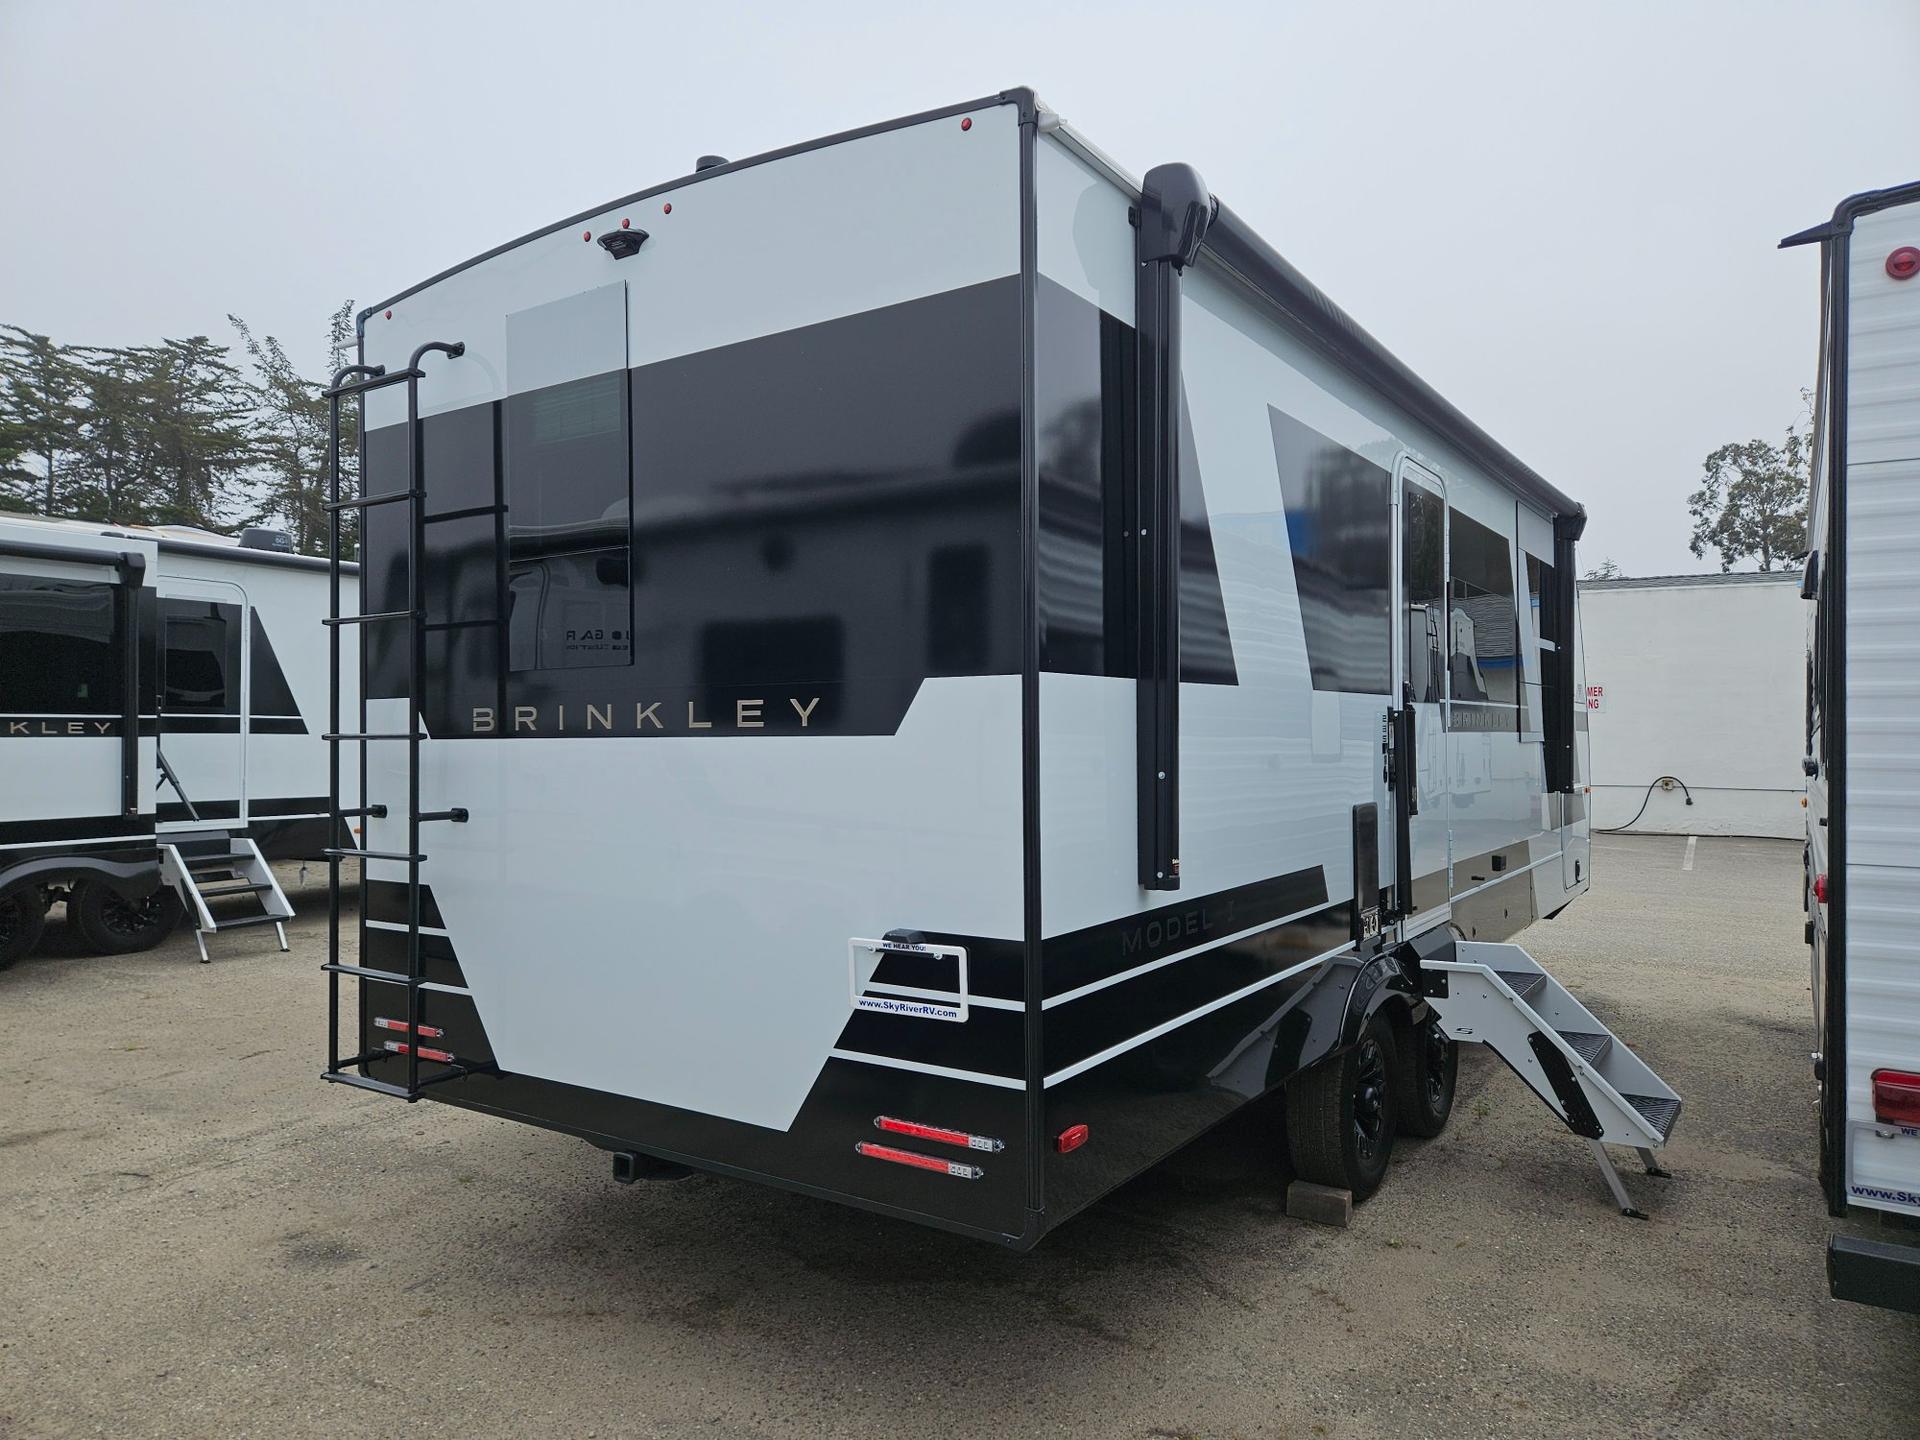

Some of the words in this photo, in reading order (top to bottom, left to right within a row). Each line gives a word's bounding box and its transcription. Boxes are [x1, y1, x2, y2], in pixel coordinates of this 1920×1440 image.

[1587, 686, 1604, 697] MER
[472, 696, 822, 733] BRINKLEY
[9, 721, 112, 735] KLEY
[1121, 907, 1214, 956] MODEL
[858, 999, 958, 1019] www.SkyRiverRV.com
[1900, 1127, 1918, 1136] WE
